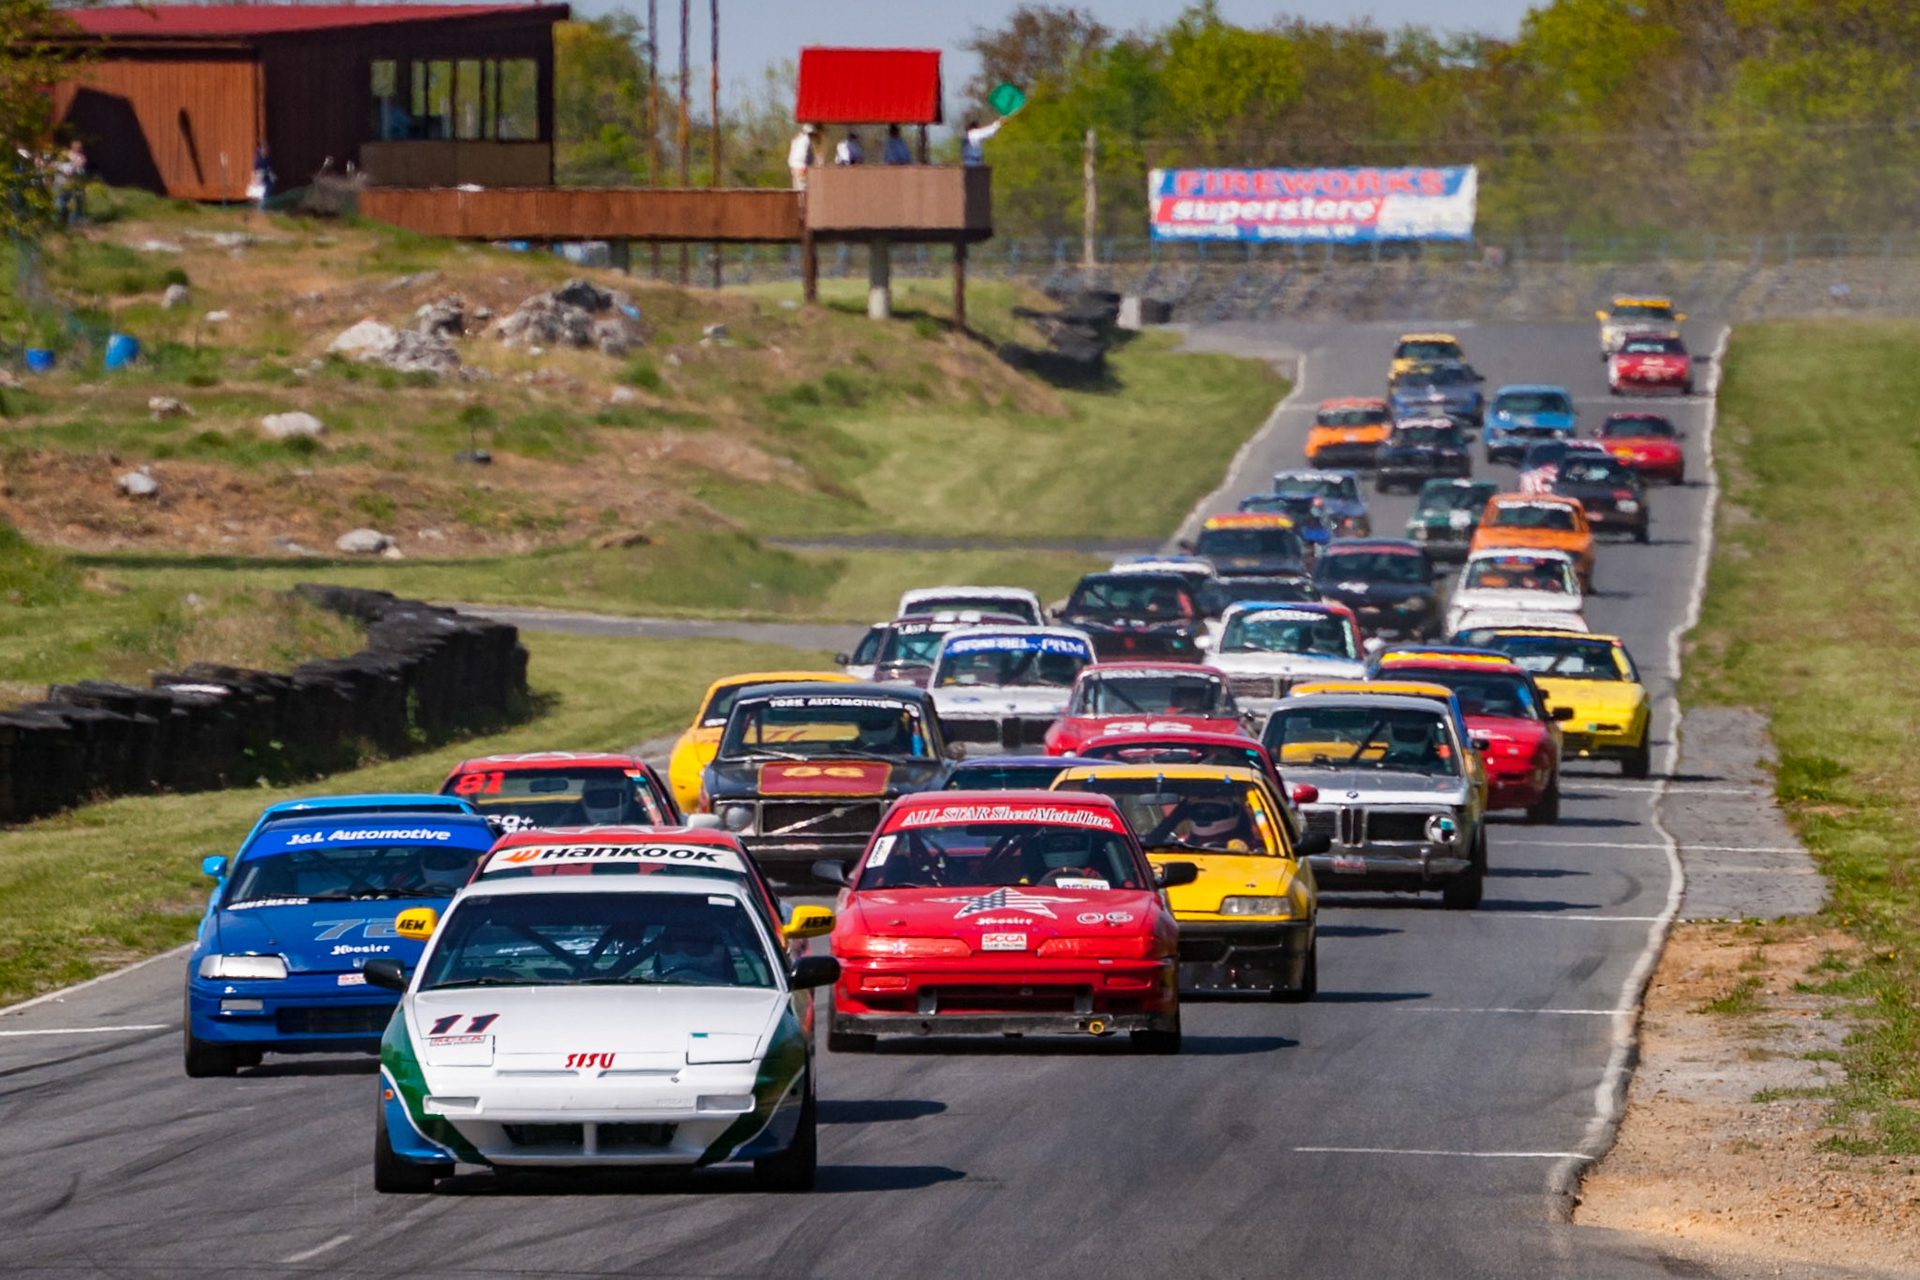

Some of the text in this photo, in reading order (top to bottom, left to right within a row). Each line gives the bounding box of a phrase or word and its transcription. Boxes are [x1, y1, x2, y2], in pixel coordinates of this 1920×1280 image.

[1174, 169, 1445, 195] FIREWORKS
[454, 771, 505, 795] 81
[900, 811, 942, 827] ALL
[942, 806, 991, 822] STAR
[286, 828, 451, 846] J&L Automotive
[1076, 911, 1134, 924] 06
[983, 935, 1025, 943] SCCA
[330, 944, 391, 955] Hoosier
[428, 1013, 501, 1035] 11
[565, 1053, 616, 1069] SISU
